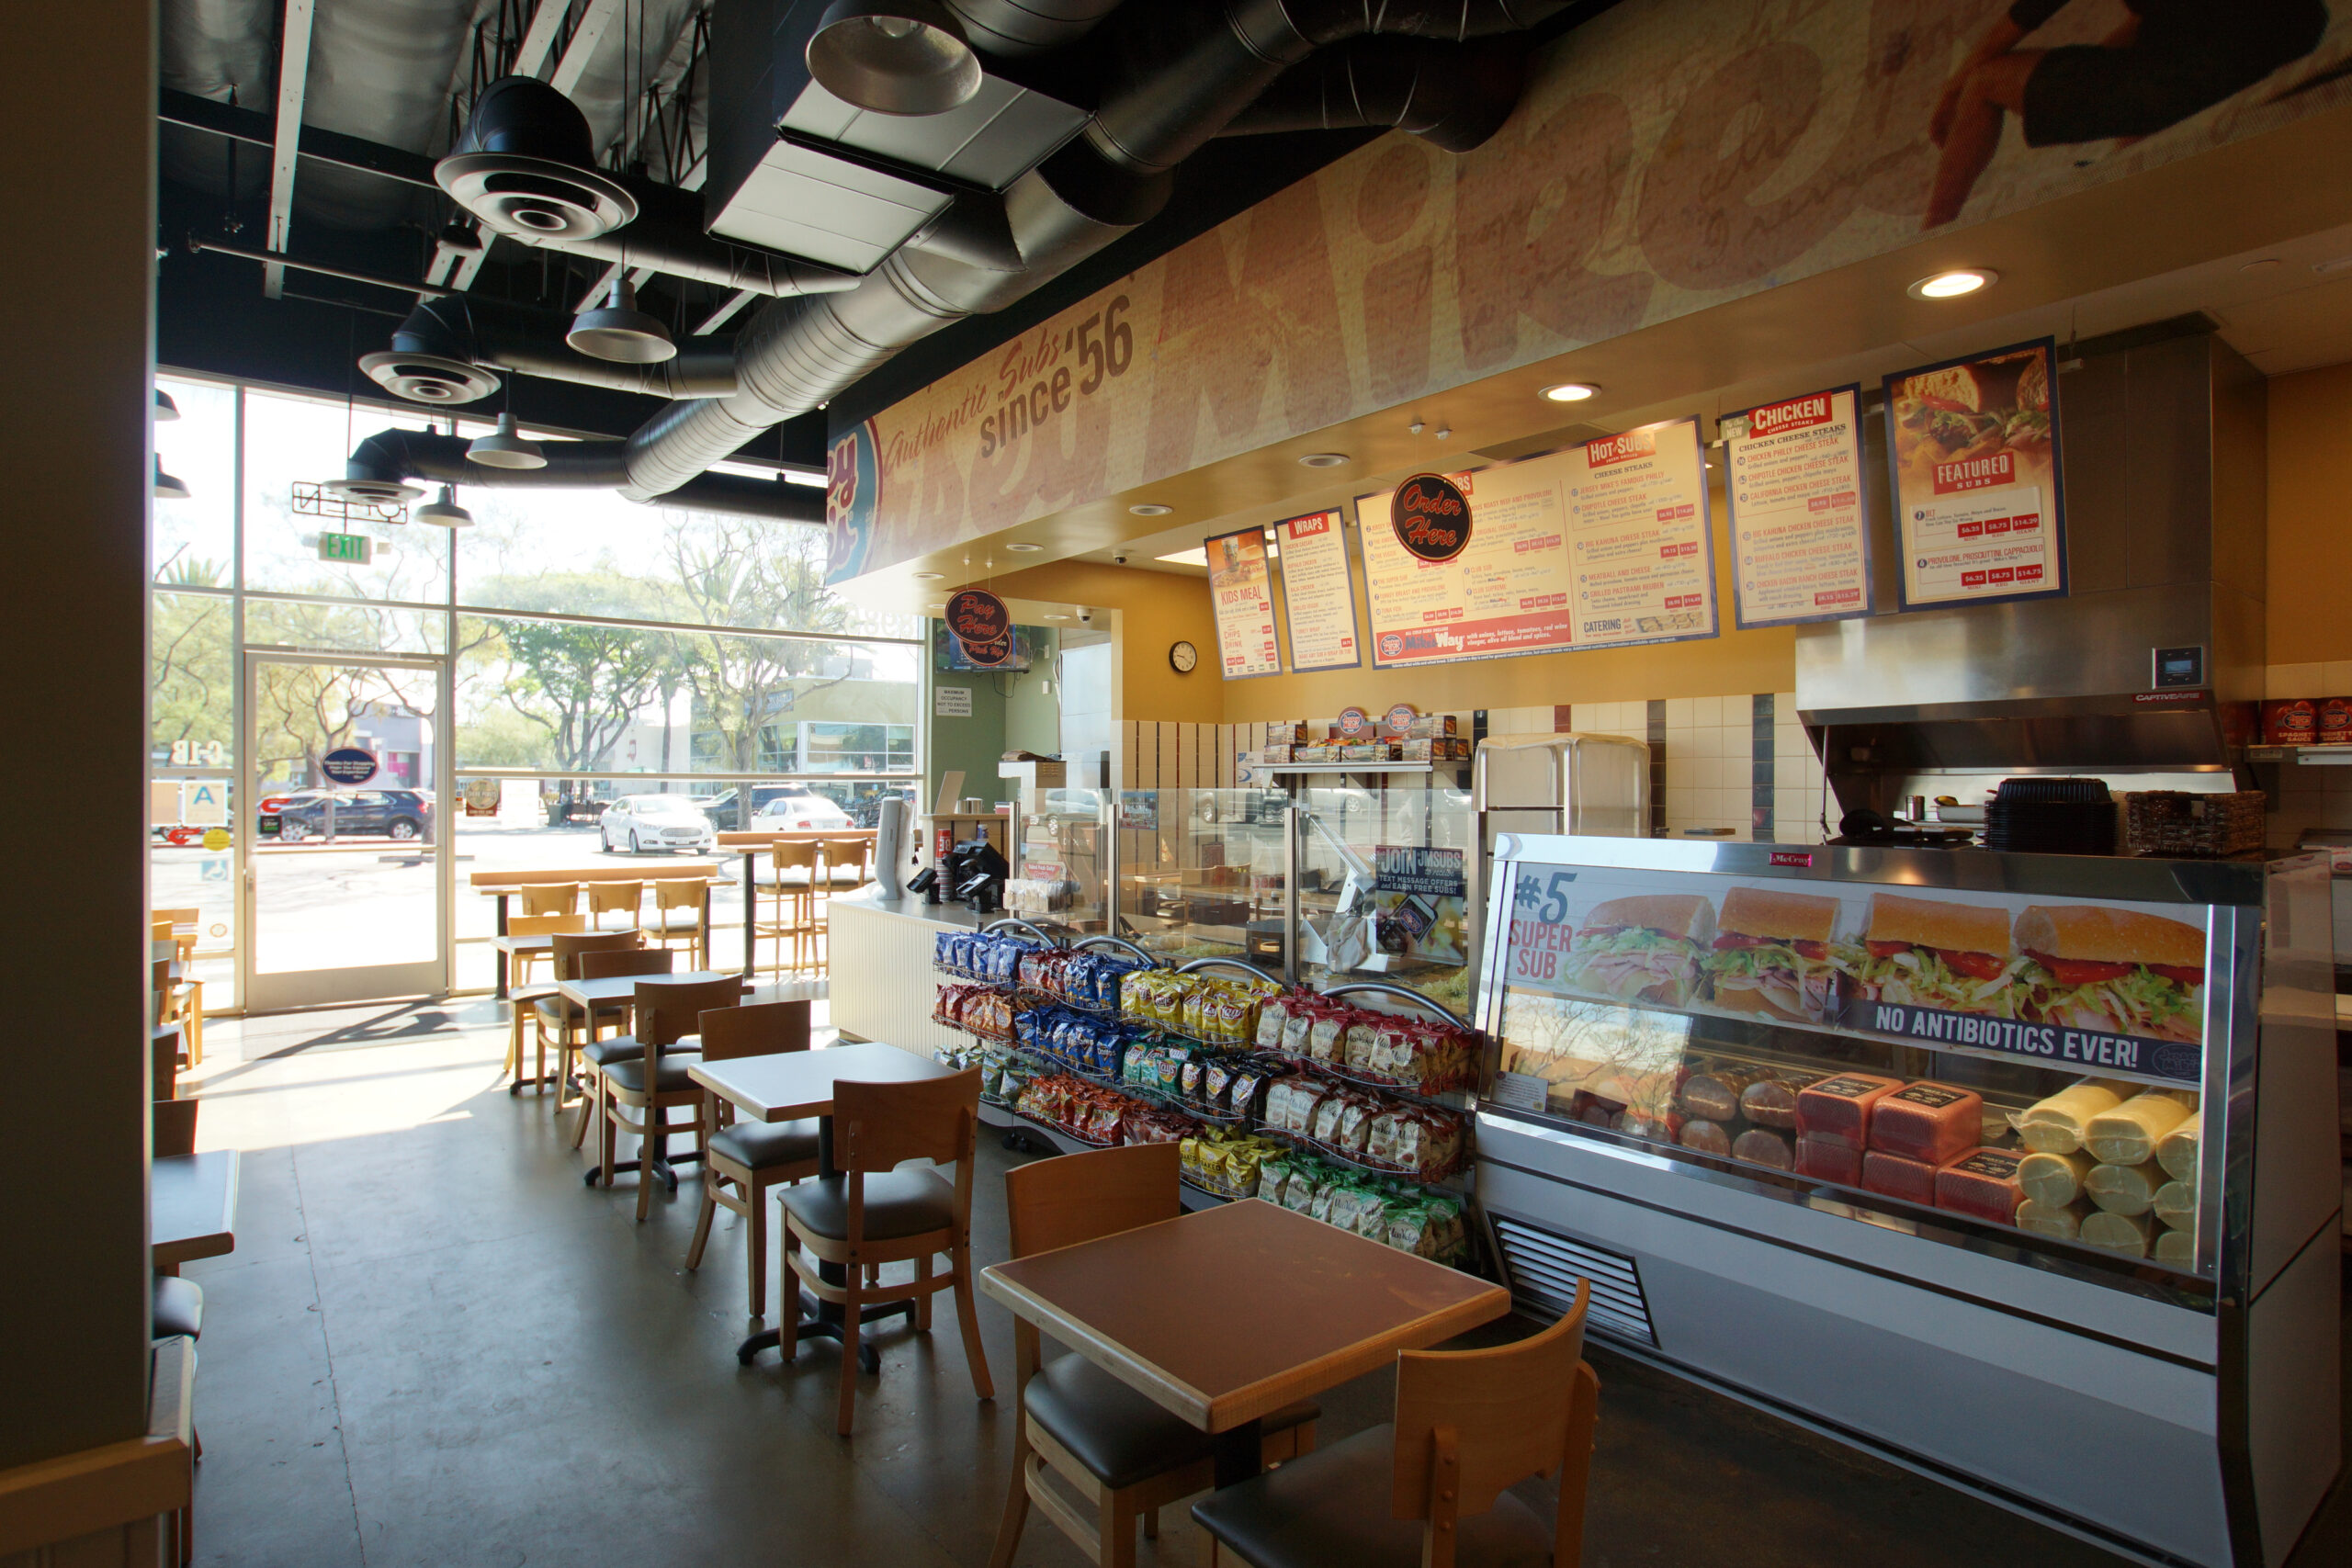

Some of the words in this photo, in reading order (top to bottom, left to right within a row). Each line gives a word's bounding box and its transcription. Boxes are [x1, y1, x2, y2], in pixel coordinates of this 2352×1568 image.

[980, 366, 1070, 458] since
[1064, 295, 1133, 396] '56
[884, 383, 990, 478] Authentic
[999, 326, 1059, 396] Subs
[1755, 398, 1825, 430] CHICKEN
[1739, 439, 1775, 452] CHICKEN
[1777, 432, 1810, 444] CHEESE
[1813, 423, 1846, 436] STEAKS
[1768, 423, 1789, 434] CHEESE
[1590, 442, 1613, 463] HOT
[1617, 434, 1651, 455] SUBS
[1747, 451, 1772, 462] CHICKEN
[1772, 447, 1792, 457] PHILLY
[1794, 442, 1815, 453] CHEESE
[1818, 437, 1838, 448] STEAK
[1594, 468, 1623, 479] CHEESE
[1623, 461, 1653, 473] STEAKS
[1645, 471, 1665, 480] PHILLY
[1748, 469, 1776, 481] CHIPOTLE
[1777, 464, 1803, 476] CHICKEN
[1804, 459, 1826, 471] CHEESE
[1827, 456, 1849, 467] STEAK
[1938, 455, 2009, 484] FEATURED
[1749, 489, 1782, 501] CALIFORNIA
[1783, 483, 1808, 493] CHICKEN
[1809, 479, 1830, 491] CHEESE
[1832, 475, 1851, 486] STEAK
[1956, 478, 1991, 490] SUBS
[1403, 484, 1462, 515] Order
[1608, 497, 1627, 506] CHEESE
[1629, 493, 1647, 502] STEAK
[1788, 522, 1812, 533] CHICKEN
[1813, 519, 1833, 529] CHEESE
[1835, 514, 1854, 525] STEAK
[1926, 509, 1935, 517] BLT
[1295, 517, 1323, 535] WRAPS
[1405, 516, 1457, 547] Here
[1620, 533, 1640, 543] CHEESE
[1641, 529, 1660, 538] STEAK
[327, 534, 364, 560] EXIT
[1781, 547, 1806, 559] CHICKEN
[1808, 545, 1830, 556] CHEESE
[1832, 542, 1853, 552] STEAK
[1589, 570, 1616, 581] MEATBALL
[1631, 566, 1651, 575] CHEESE
[1838, 568, 1858, 577] STEAK
[1220, 590, 1238, 606] KIDS
[1240, 585, 1262, 601] MEAL
[1590, 588, 1611, 598] GRILLED
[1612, 585, 1642, 595] PASTRAMI
[1643, 582, 1664, 592] REUBEN
[960, 595, 995, 620] Pay
[957, 615, 997, 636] Here
[1584, 618, 1622, 633] CATERING
[1436, 633, 1463, 651] Way
[192, 785, 215, 806] A
[1381, 848, 1417, 874] JOIN
[1418, 851, 1461, 869] JMSUBS
[1397, 876, 1429, 885] MESSAGE
[1515, 872, 1577, 925] #5
[1510, 919, 1573, 953] SUPER
[1517, 948, 1556, 979] SUB
[1875, 1006, 1905, 1032] NO
[1911, 1011, 2054, 1055] ANTIBIOTICS
[2063, 1032, 2139, 1068] EVER!
[1202, 1160, 1220, 1171] BAKED
